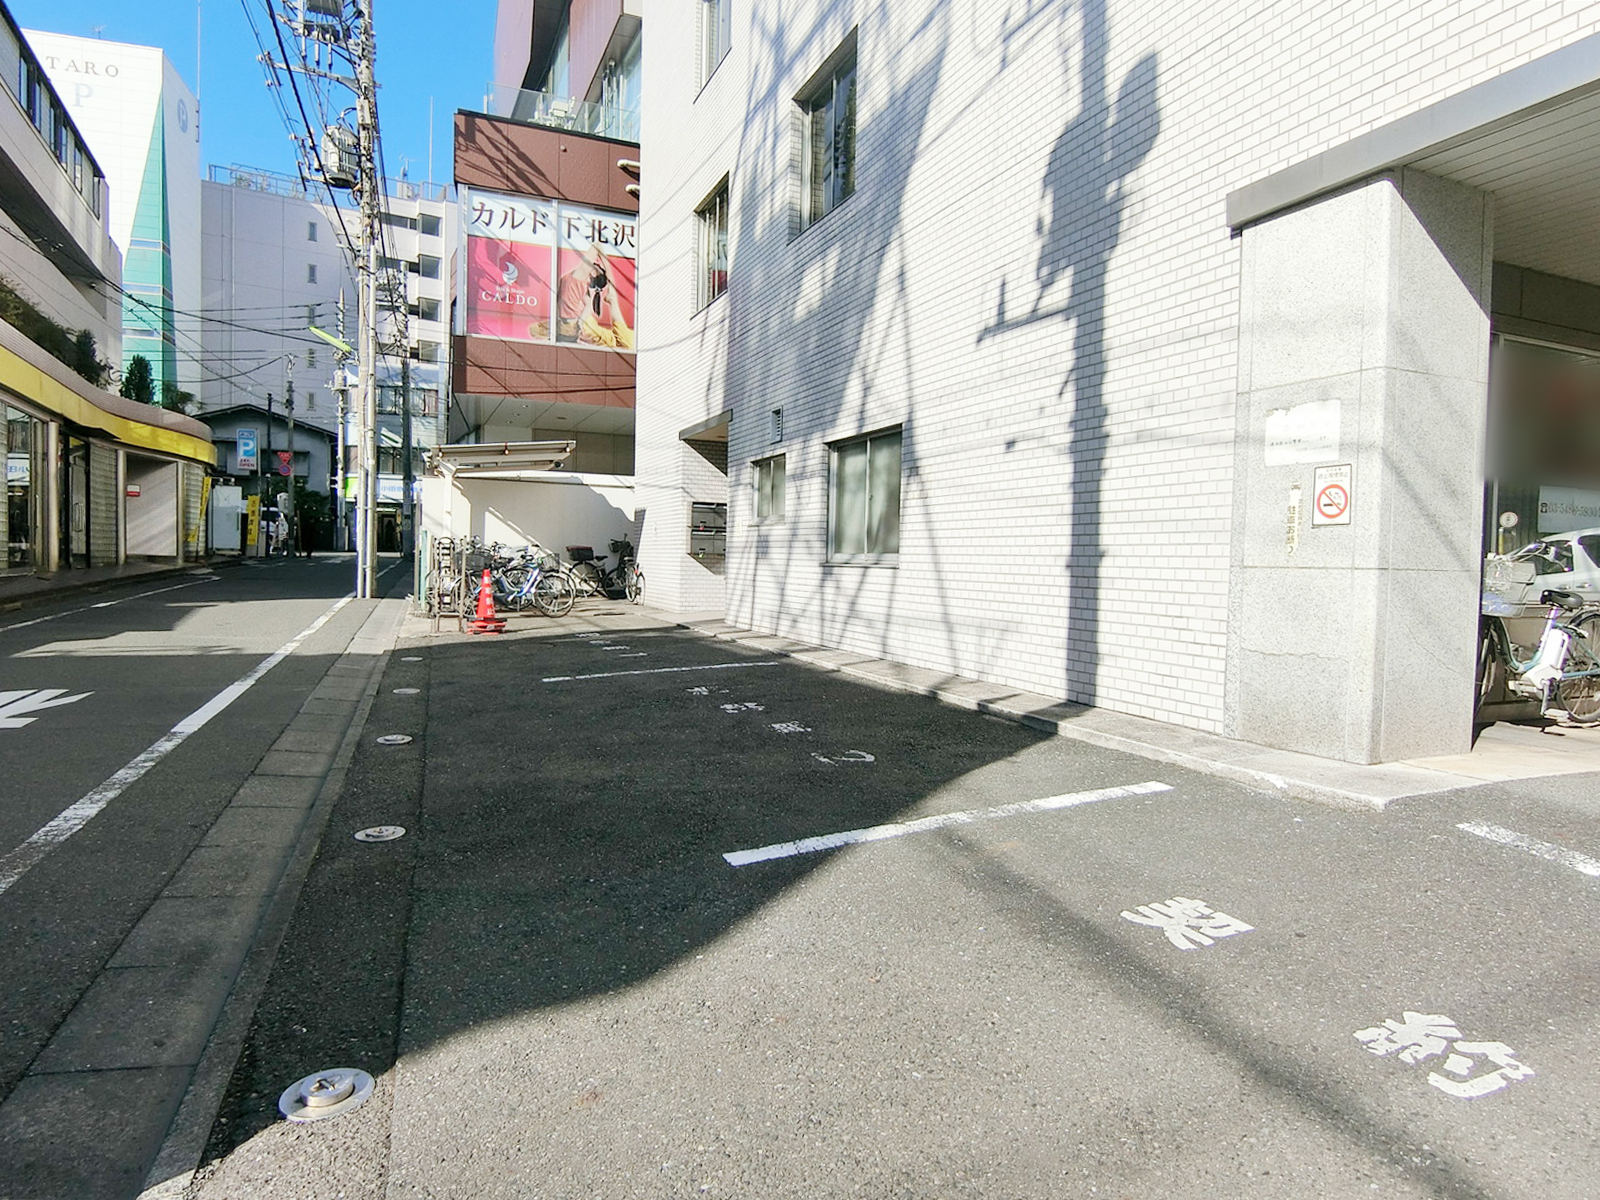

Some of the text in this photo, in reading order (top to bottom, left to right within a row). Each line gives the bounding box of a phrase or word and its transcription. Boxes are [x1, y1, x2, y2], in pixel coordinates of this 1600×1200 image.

[46, 56, 119, 78] TARO
[71, 82, 94, 107] P
[471, 202, 636, 248] カルド 下北沢
[482, 291, 538, 307] CALDO
[239, 439, 255, 457] P
